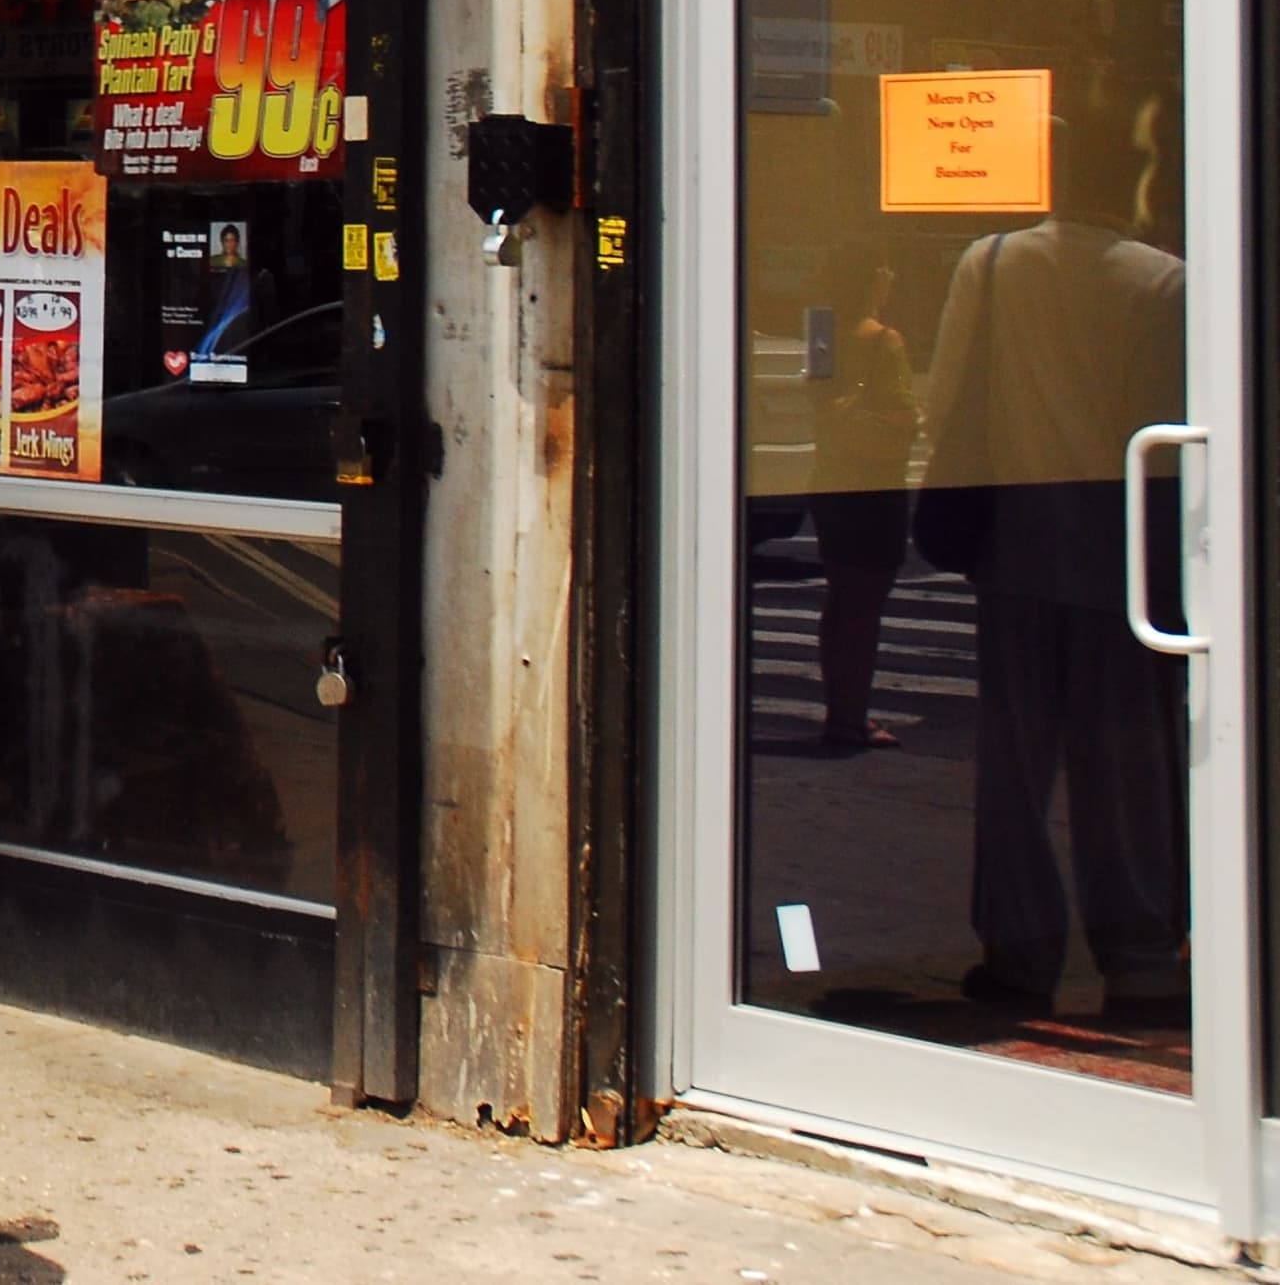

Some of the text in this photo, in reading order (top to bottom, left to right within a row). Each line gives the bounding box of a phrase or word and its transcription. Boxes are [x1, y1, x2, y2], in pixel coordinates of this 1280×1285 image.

[160, 24, 200, 61] Patty
[100, 59, 194, 95] Plantain Tart
[968, 91, 996, 104] PCS
[3, 187, 85, 258] Deals
[13, 425, 75, 467] Jerk Wings
